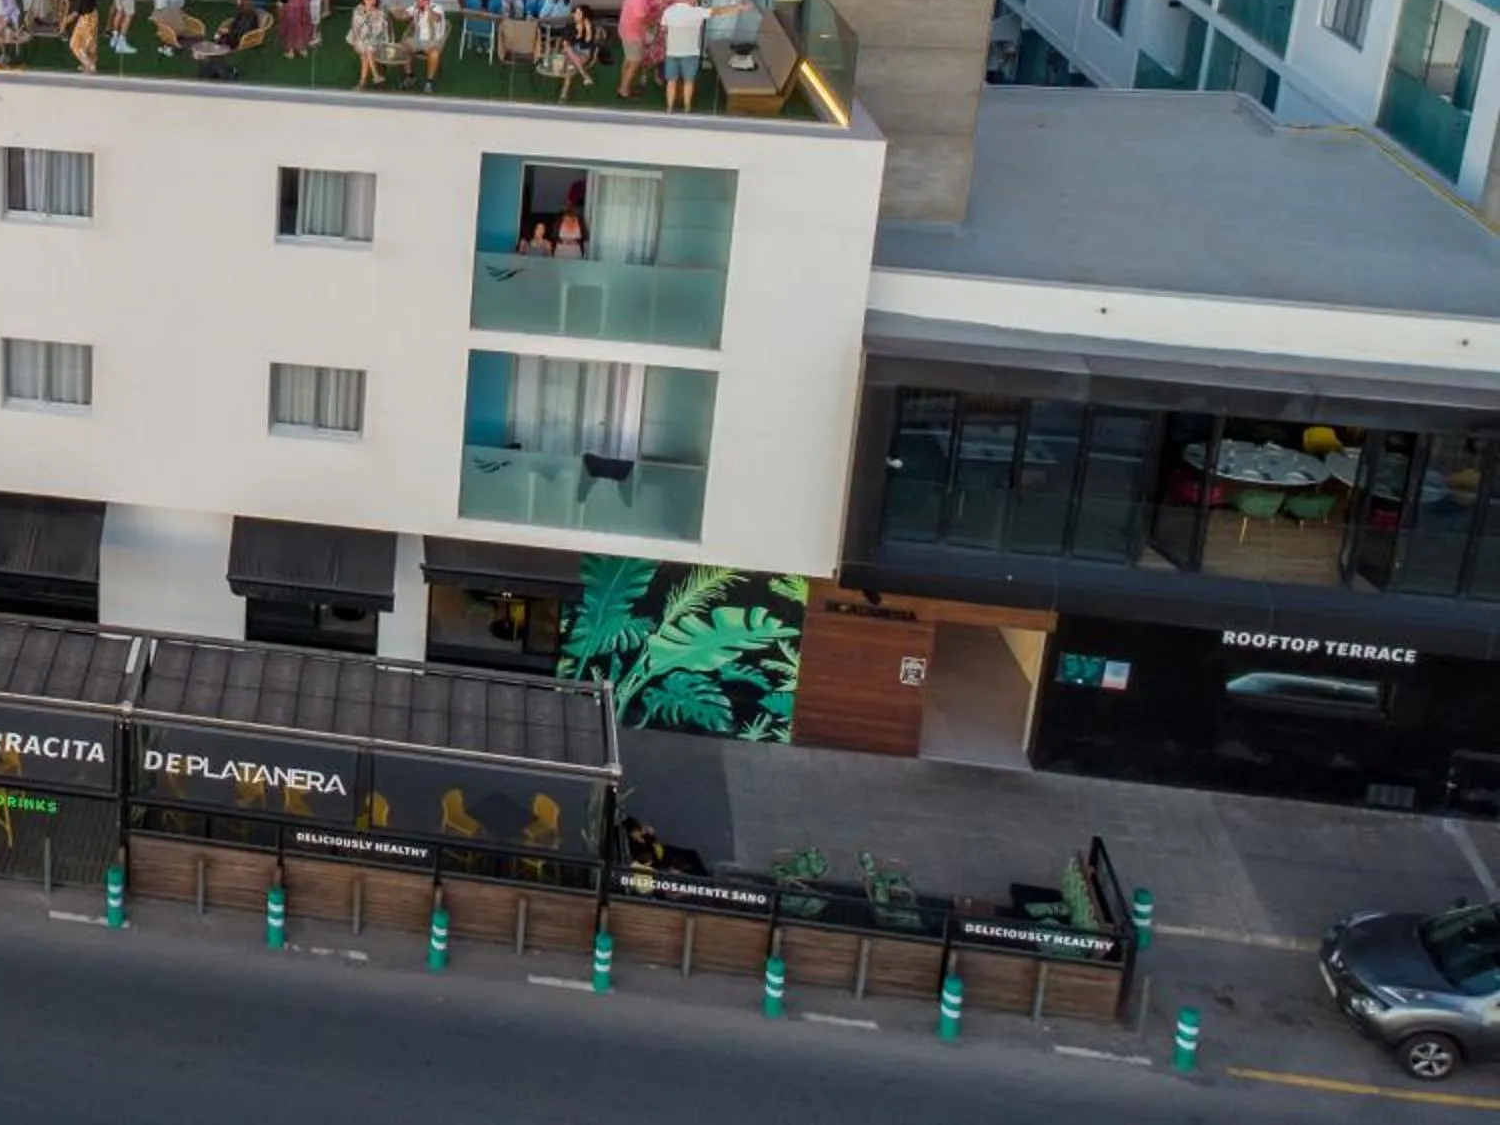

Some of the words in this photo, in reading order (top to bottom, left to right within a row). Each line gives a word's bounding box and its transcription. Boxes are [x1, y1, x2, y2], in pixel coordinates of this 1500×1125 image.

[1222, 630, 1319, 653] ROOFTOP
[1324, 640, 1417, 664] TERRACE
[143, 750, 181, 773] DE
[187, 755, 347, 796] PLATANERA
[296, 832, 373, 851] DELICIOUSLY
[375, 842, 429, 858] HEALTHY
[620, 876, 730, 899] DELICIOSAMENTE
[731, 890, 766, 904] SANO
[964, 922, 1052, 943] DELICIOUSLY
[1053, 935, 1114, 952] HEALTHY
